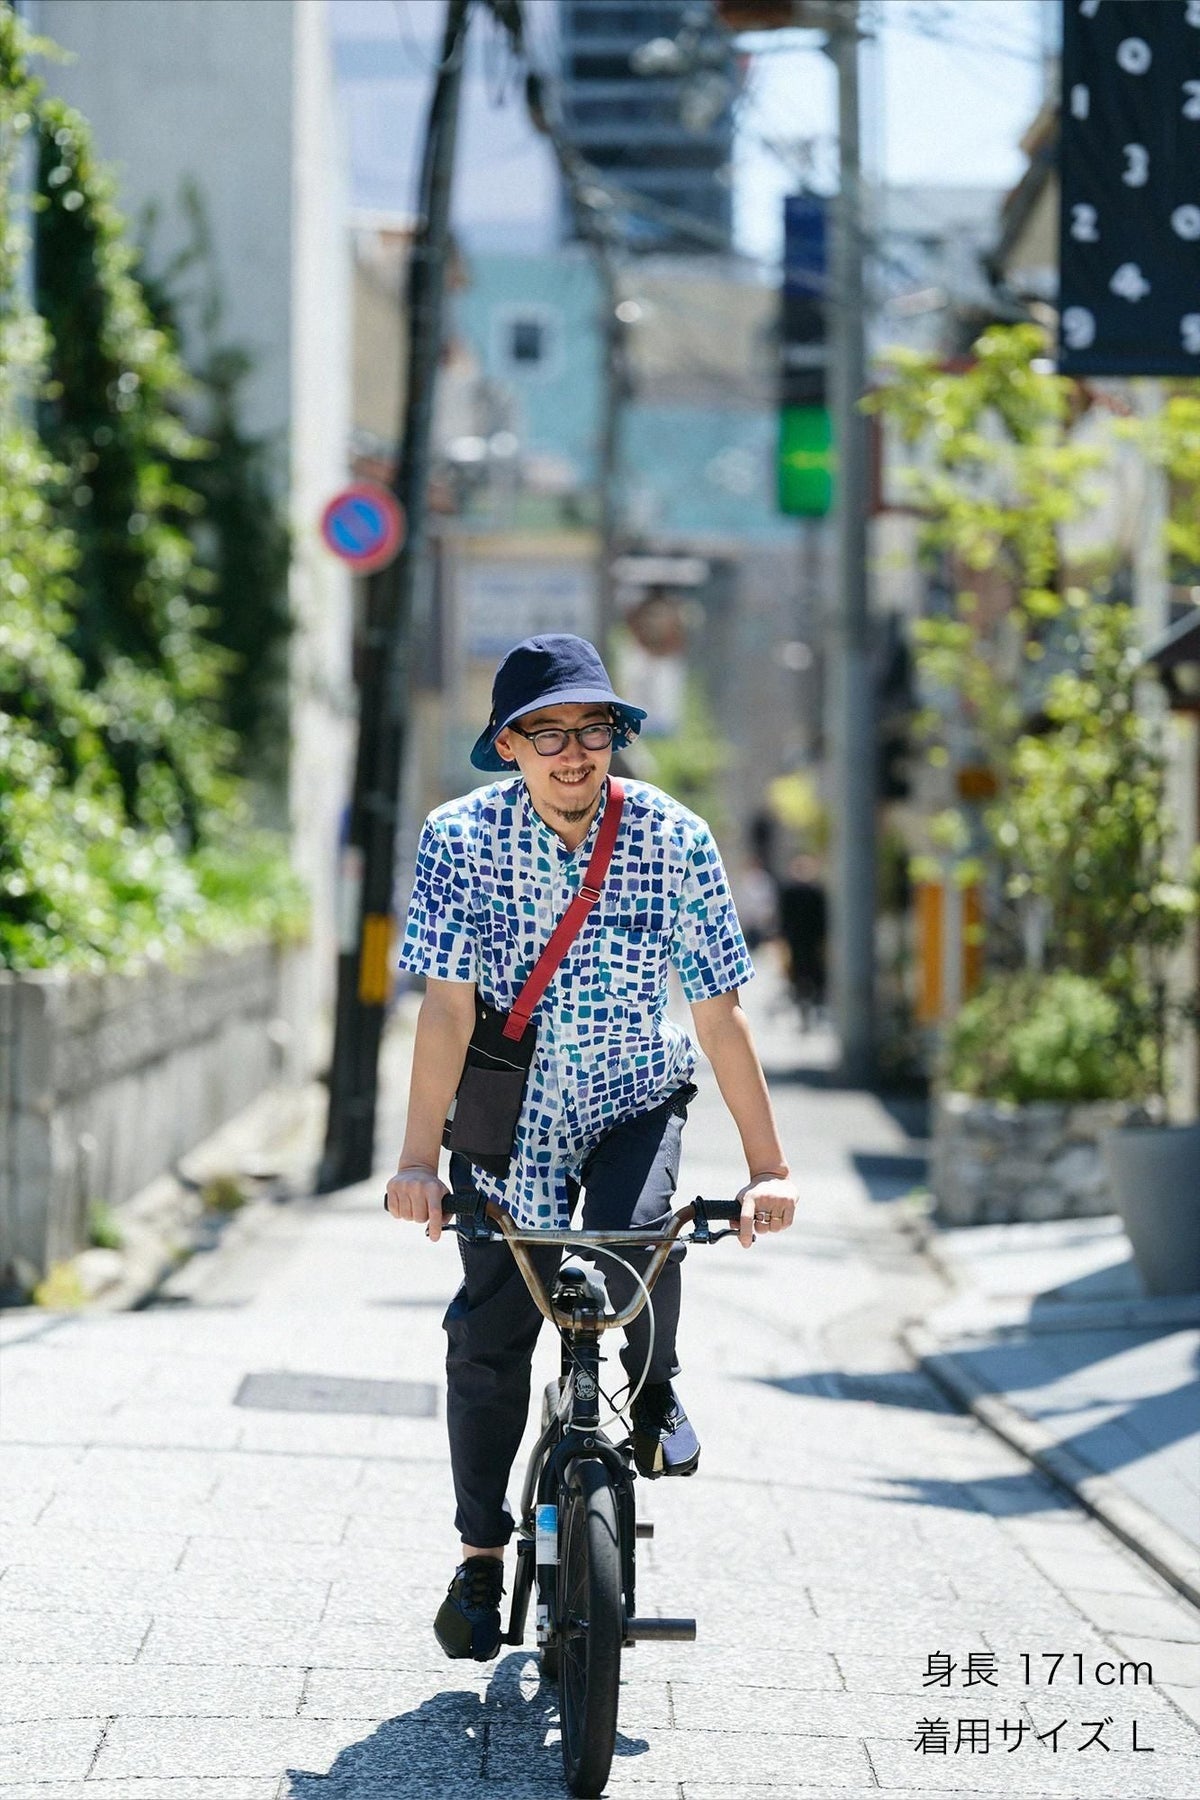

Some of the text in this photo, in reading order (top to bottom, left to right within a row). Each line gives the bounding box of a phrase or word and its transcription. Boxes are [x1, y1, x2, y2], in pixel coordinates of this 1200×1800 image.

[1123, 143, 1149, 187] 3
[1071, 204, 1098, 241] 2
[1110, 263, 1150, 302] 4
[1062, 306, 1095, 349] 9
